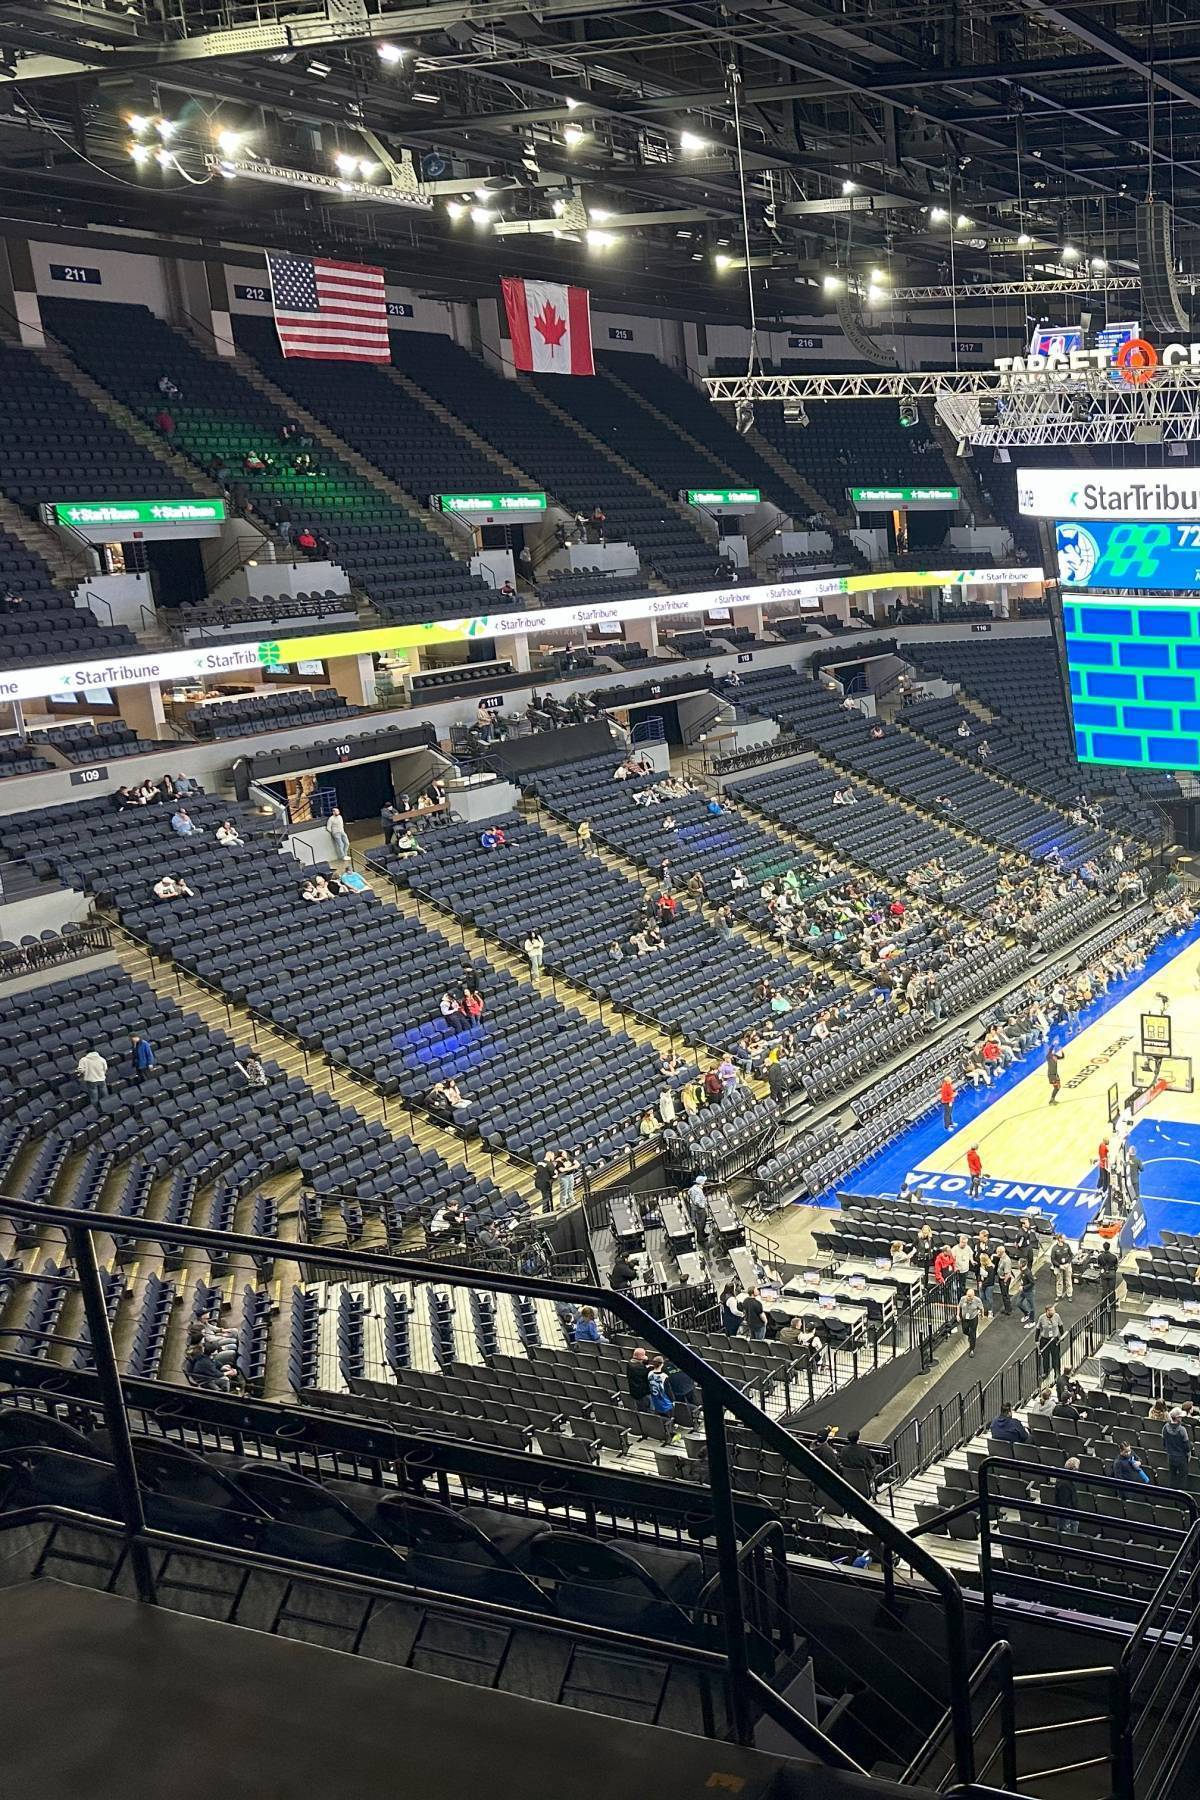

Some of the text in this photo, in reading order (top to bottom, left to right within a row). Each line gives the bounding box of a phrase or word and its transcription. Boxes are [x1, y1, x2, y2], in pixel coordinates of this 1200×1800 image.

[64, 267, 86, 282] 211
[245, 287, 265, 300] 212
[389, 304, 405, 316] 213
[615, 329, 628, 339] 215
[798, 338, 813, 348] 216
[959, 343, 974, 352] 217
[986, 571, 1029, 581] StarTribune
[500, 616, 547, 631] StarTribune
[577, 608, 618, 622] StarTribune
[652, 600, 689, 613] StarTribune
[718, 592, 751, 605] StarTribune
[74, 664, 160, 686] StarTribune
[650, 685, 661, 695] 112
[486, 698, 498, 707] 111
[335, 744, 350, 755] 110
[80, 769, 100, 783] 109
[1063, 1033, 1135, 1090] TARGET CENTER
